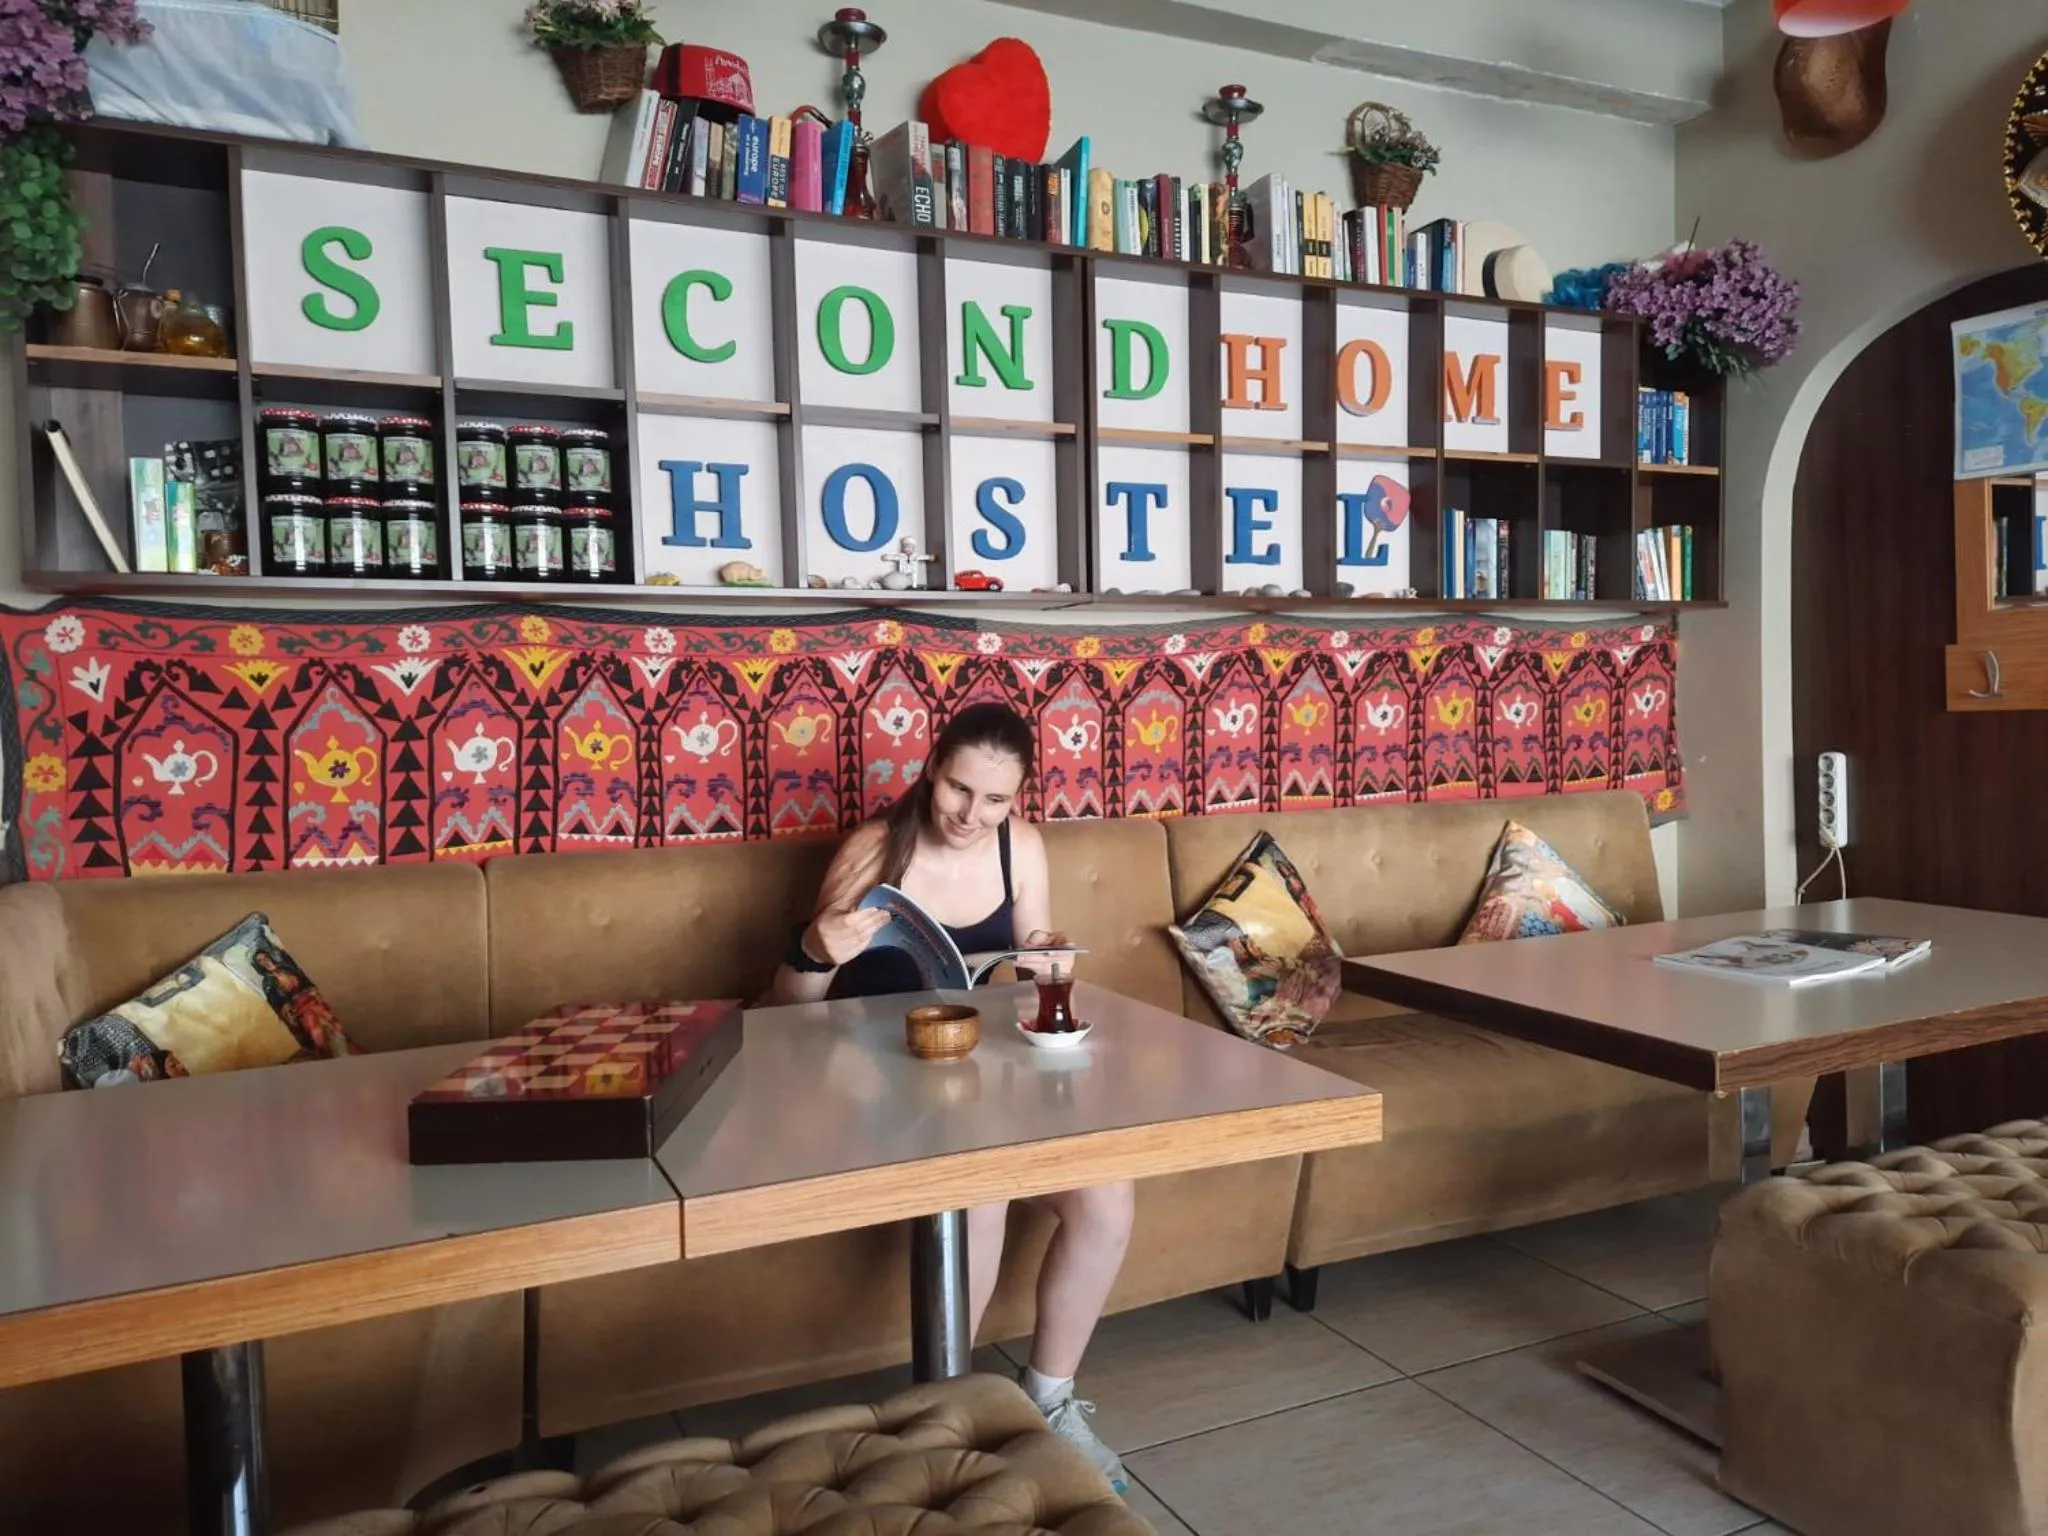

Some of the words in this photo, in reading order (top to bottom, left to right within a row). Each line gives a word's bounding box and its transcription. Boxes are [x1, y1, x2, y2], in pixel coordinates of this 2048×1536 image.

[751, 135, 760, 174] europe
[771, 157, 780, 198] EUROPE
[779, 184, 785, 196] OF
[914, 186, 932, 223] ECHO
[302, 227, 1169, 398] SECOND
[1219, 334, 1584, 431] HOME
[659, 460, 1389, 567] HOSTEL
